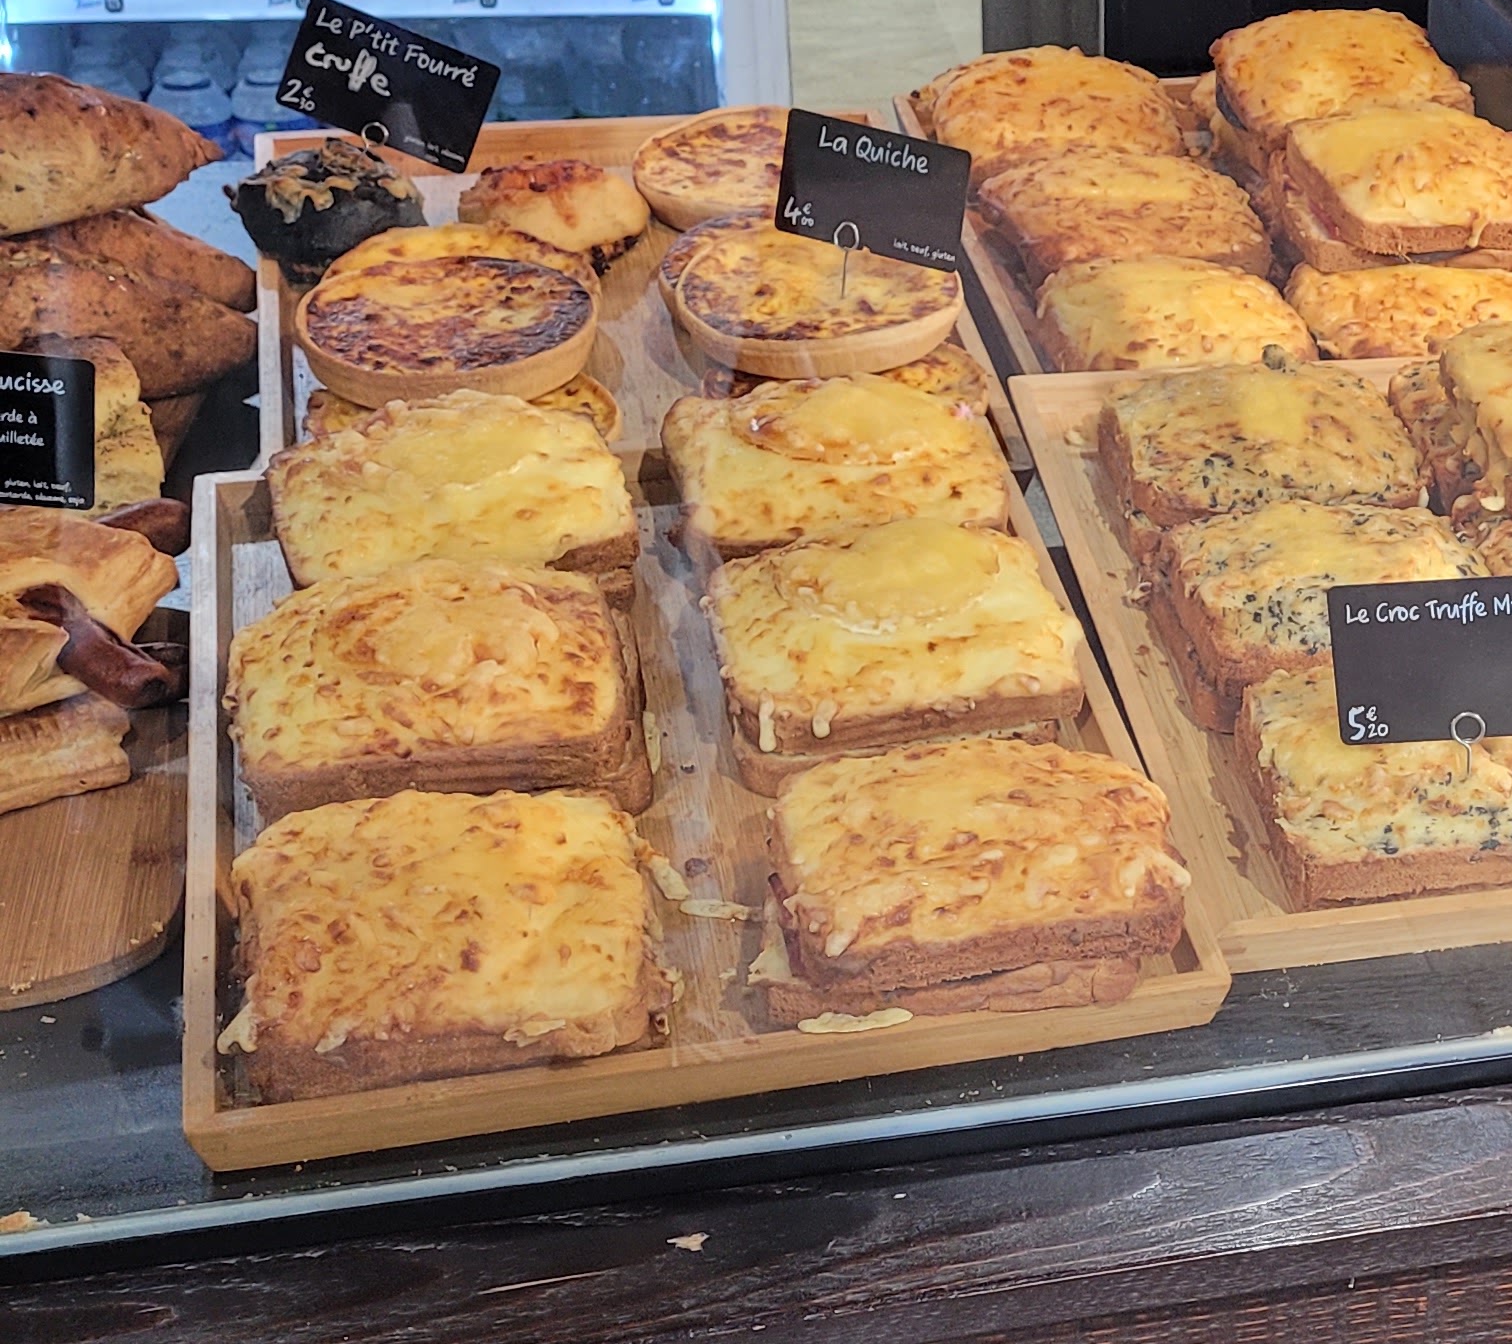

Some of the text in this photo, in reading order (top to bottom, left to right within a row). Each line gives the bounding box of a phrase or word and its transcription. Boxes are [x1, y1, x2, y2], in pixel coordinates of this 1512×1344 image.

[315, 6, 479, 88] Le P'tit Fourré
[818, 125, 929, 174] La Quiche
[931, 248, 956, 262] gluten
[27, 410, 38, 425] à
[1345, 604, 1370, 625] Le
[1375, 602, 1420, 624] Croc
[1425, 590, 1488, 625] Truffe
